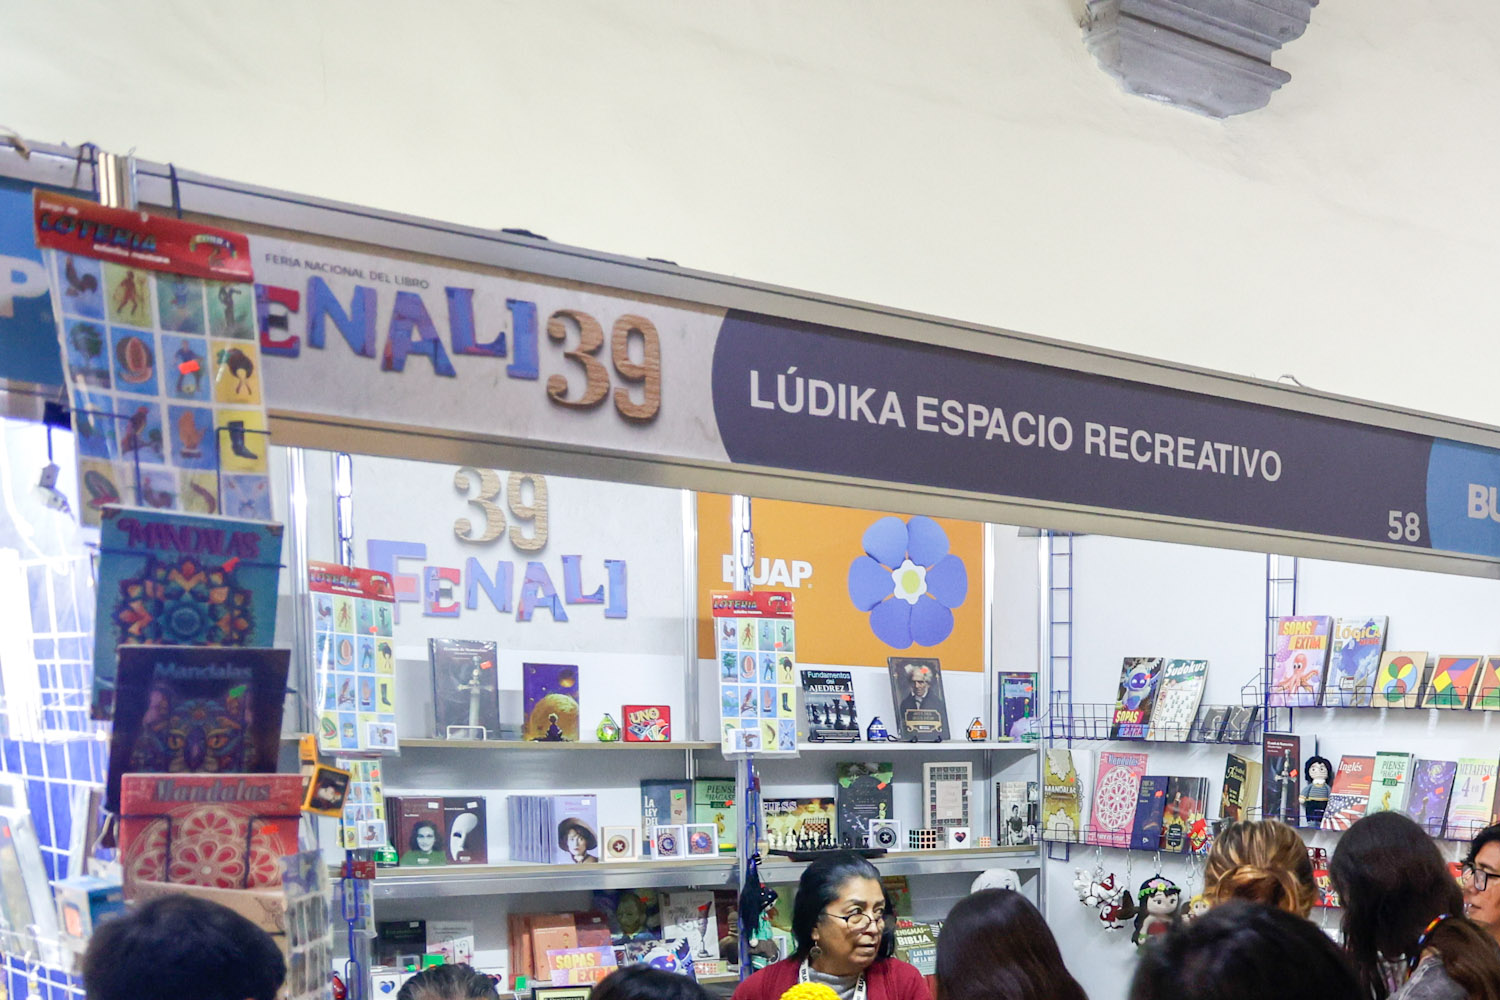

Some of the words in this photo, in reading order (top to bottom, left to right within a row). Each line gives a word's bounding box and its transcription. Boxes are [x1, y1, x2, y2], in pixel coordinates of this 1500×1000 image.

[265, 253, 301, 268] FERIA
[304, 261, 366, 279] NACIONAL
[369, 271, 391, 284] DEL
[394, 275, 429, 289] LIBRO
[255, 275, 540, 380] ENALI
[749, 366, 906, 428] LÚDIKA
[916, 395, 1073, 452] ESPACIO
[1084, 422, 1283, 482] RECREATIVO
[454, 466, 549, 551] 39
[1387, 510, 1421, 542] 58
[1283, 621, 1312, 635] SOPAS
[1165, 661, 1206, 677] Sudokus
[809, 685, 845, 693] AJEDREZ
[847, 681, 853, 692] 1
[629, 708, 660, 724] UNO
[1115, 711, 1139, 724] SOPAS
[1339, 761, 1364, 774] Inglés
[1382, 760, 1406, 770] PIENSE
[1461, 776, 1471, 797] 4
[644, 795, 655, 808] LA
[644, 808, 658, 817] LEY
[896, 934, 931, 946] BIBLIA
[555, 952, 595, 969] SOPAS
